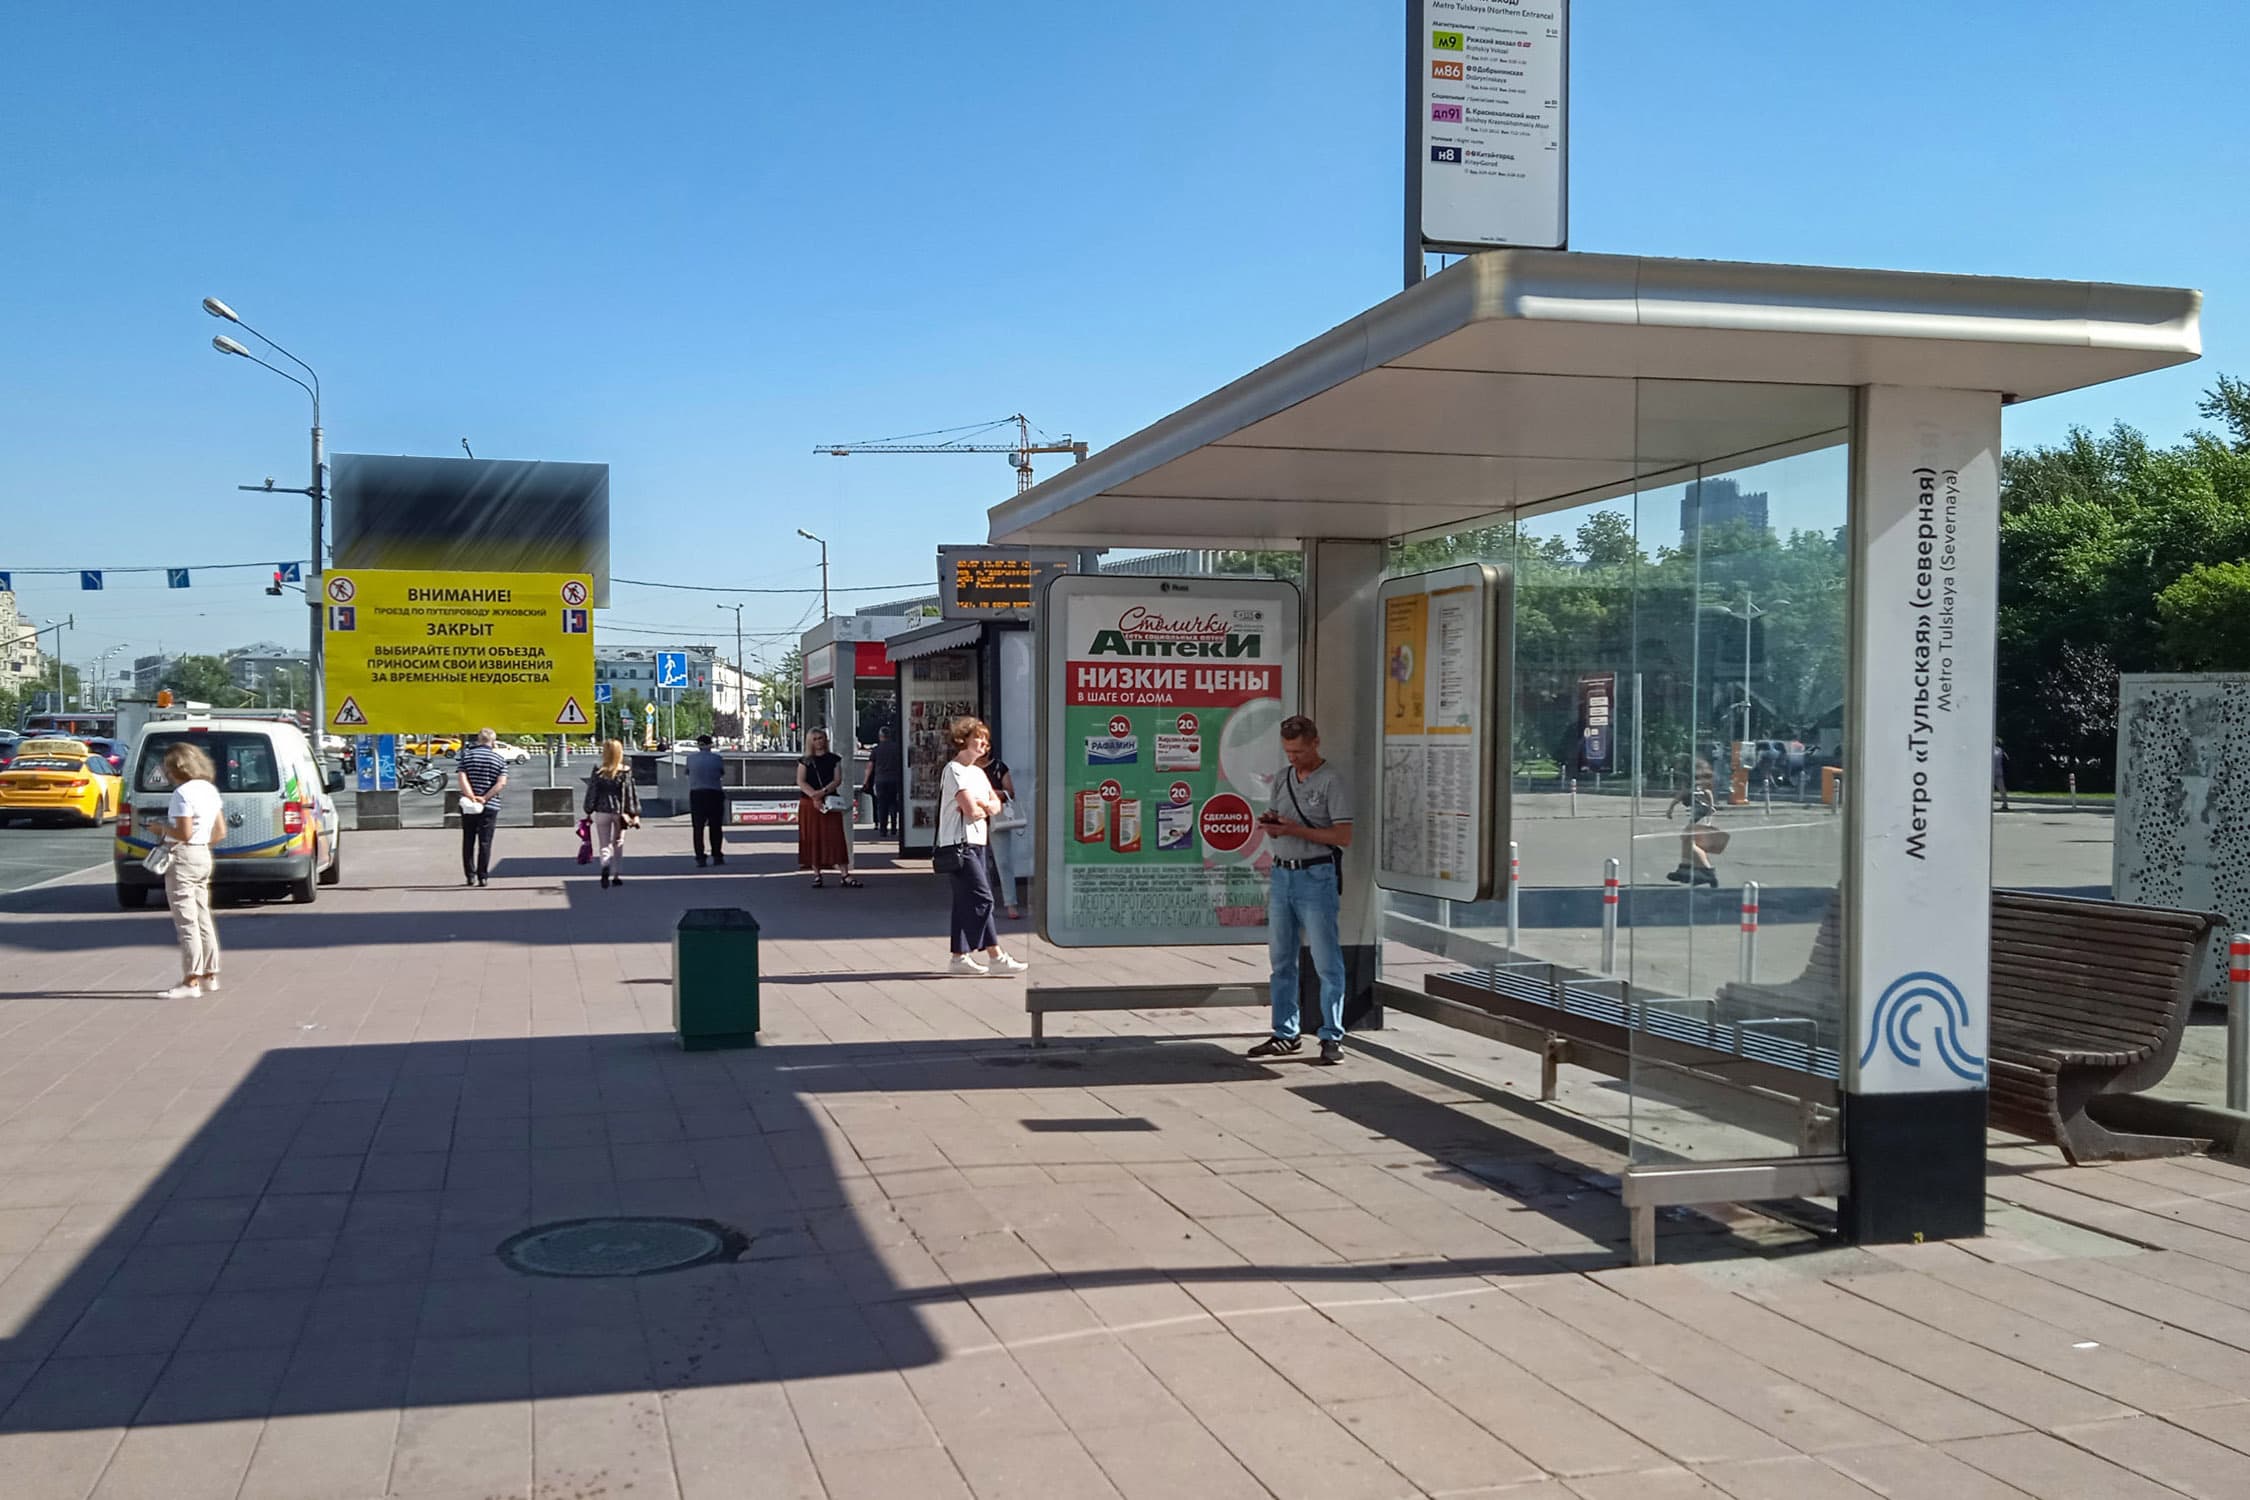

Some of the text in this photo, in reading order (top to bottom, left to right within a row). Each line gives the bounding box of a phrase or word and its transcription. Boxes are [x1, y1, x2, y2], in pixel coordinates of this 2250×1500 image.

[1432, 2, 1554, 20] Metro Tulskaya (Northern Entrance)
[1439, 36, 1457, 48] м9
[1434, 65, 1461, 78] м86
[1434, 108, 1460, 120] дп91
[1438, 149, 1454, 160] н8
[408, 588, 512, 603] ВНИМАНИЕ!
[1938, 470, 1960, 712] Metro Tulskaya (Severnaya)
[374, 607, 547, 617] ПРОЕЗД ПО ПУТЕПРОВОДУ ЖУКОВСКИЙ
[1118, 606, 1232, 633] Столички
[427, 623, 494, 636] ЗАКРЫТ
[374, 645, 545, 658] ВЫБИРАЙТЕ ПУТИ ОБЪЕЗДА
[367, 658, 553, 670] ПРИНОСИМ СВОИ ИЗВИНЕНИЯ
[1906, 468, 1938, 860] Метро «Тульская» (северная)
[371, 672, 550, 684] ЗА ВРЕМЕННЫЕ НЕУДОБСТВА
[1078, 667, 1269, 693] НИЗКИЕ ЦЕНЫ
[1078, 692, 1173, 704] В ШАГЕ ОТ ДОМА
[1091, 741, 1135, 750] РАФАМИН
[1204, 813, 1242, 821] СДЕЛАНО
[1204, 824, 1250, 834] РОССИИ
